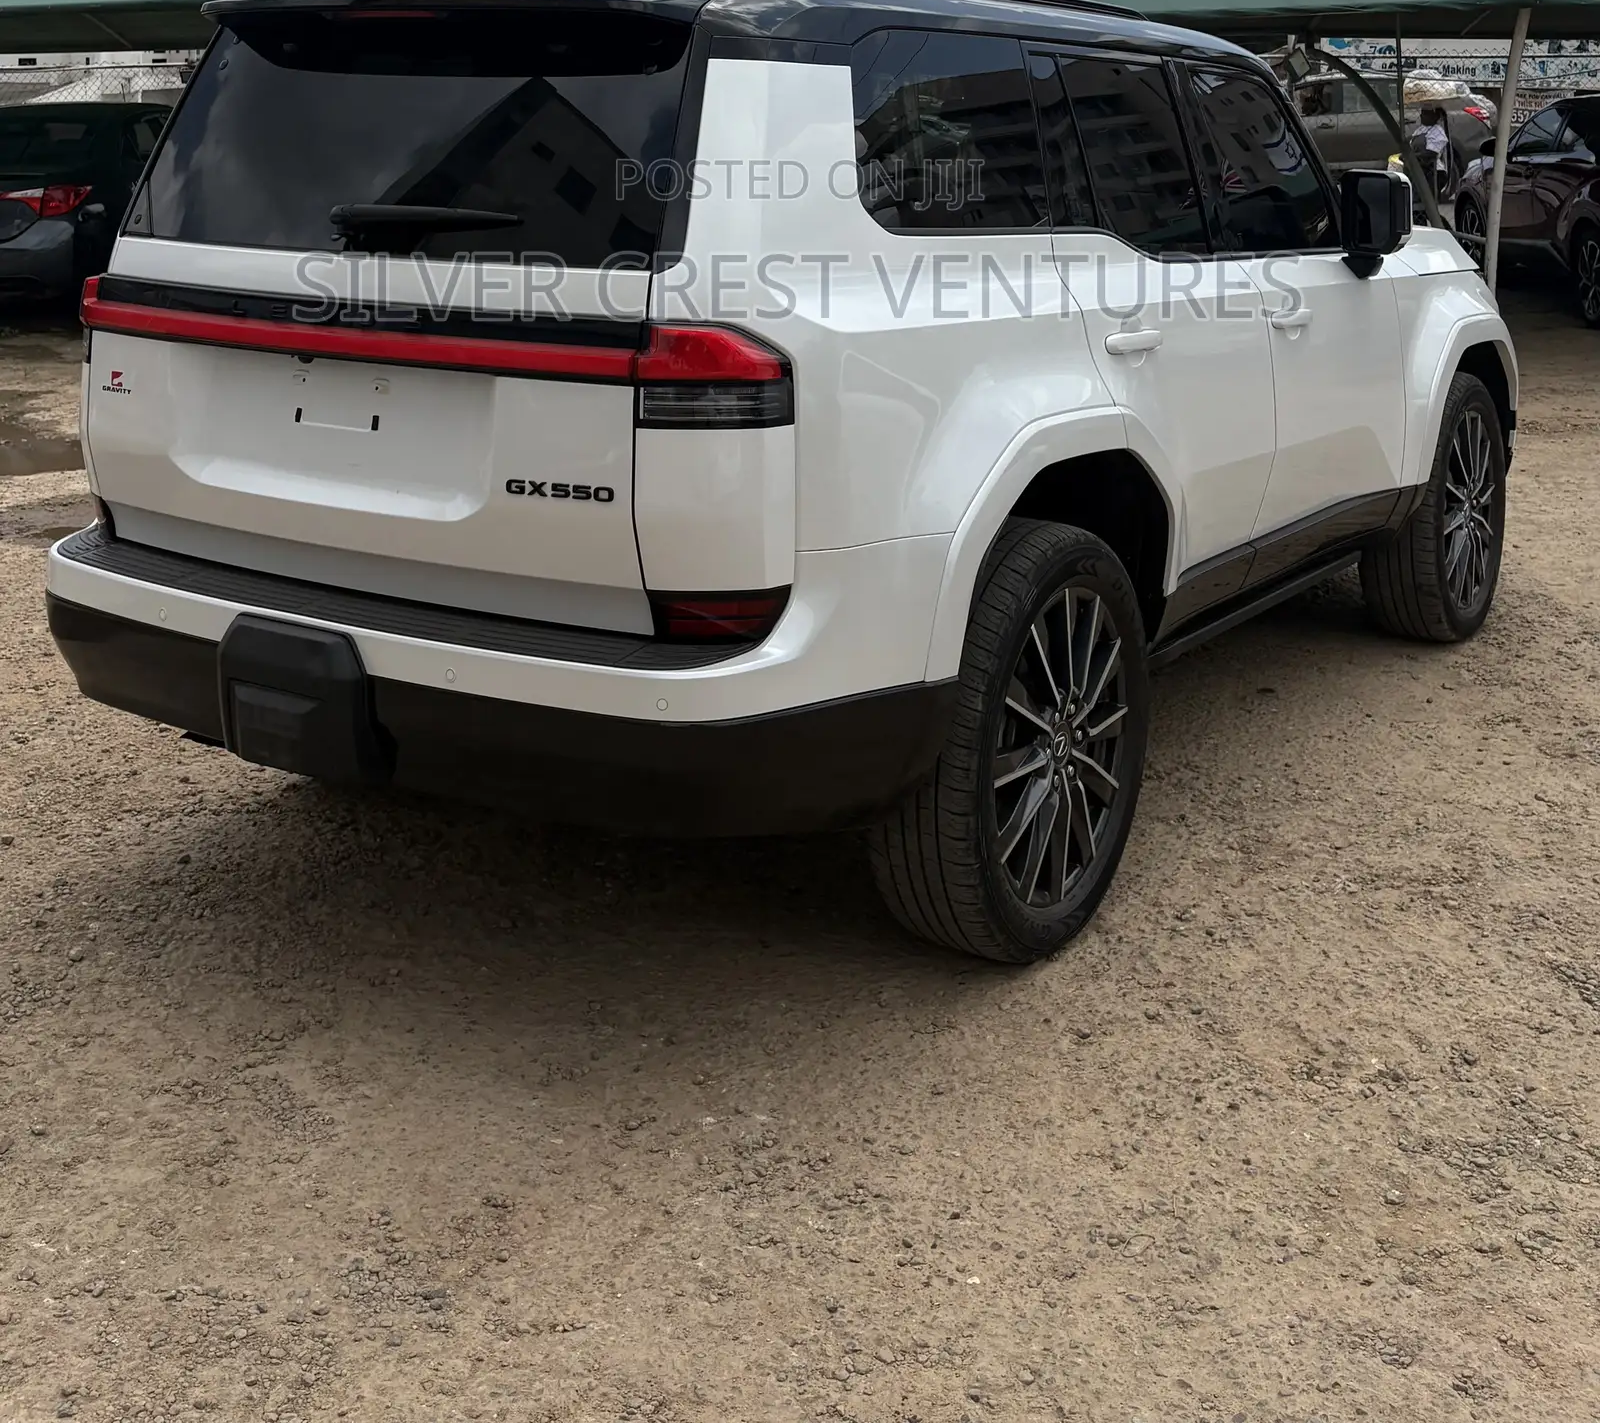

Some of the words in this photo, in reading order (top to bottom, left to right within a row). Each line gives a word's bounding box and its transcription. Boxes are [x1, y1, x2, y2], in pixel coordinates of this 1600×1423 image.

[1442, 64, 1477, 77] Making
[232, 299, 422, 329] LEUS
[102, 385, 132, 395] GRAVITY
[505, 479, 615, 503] GX550
